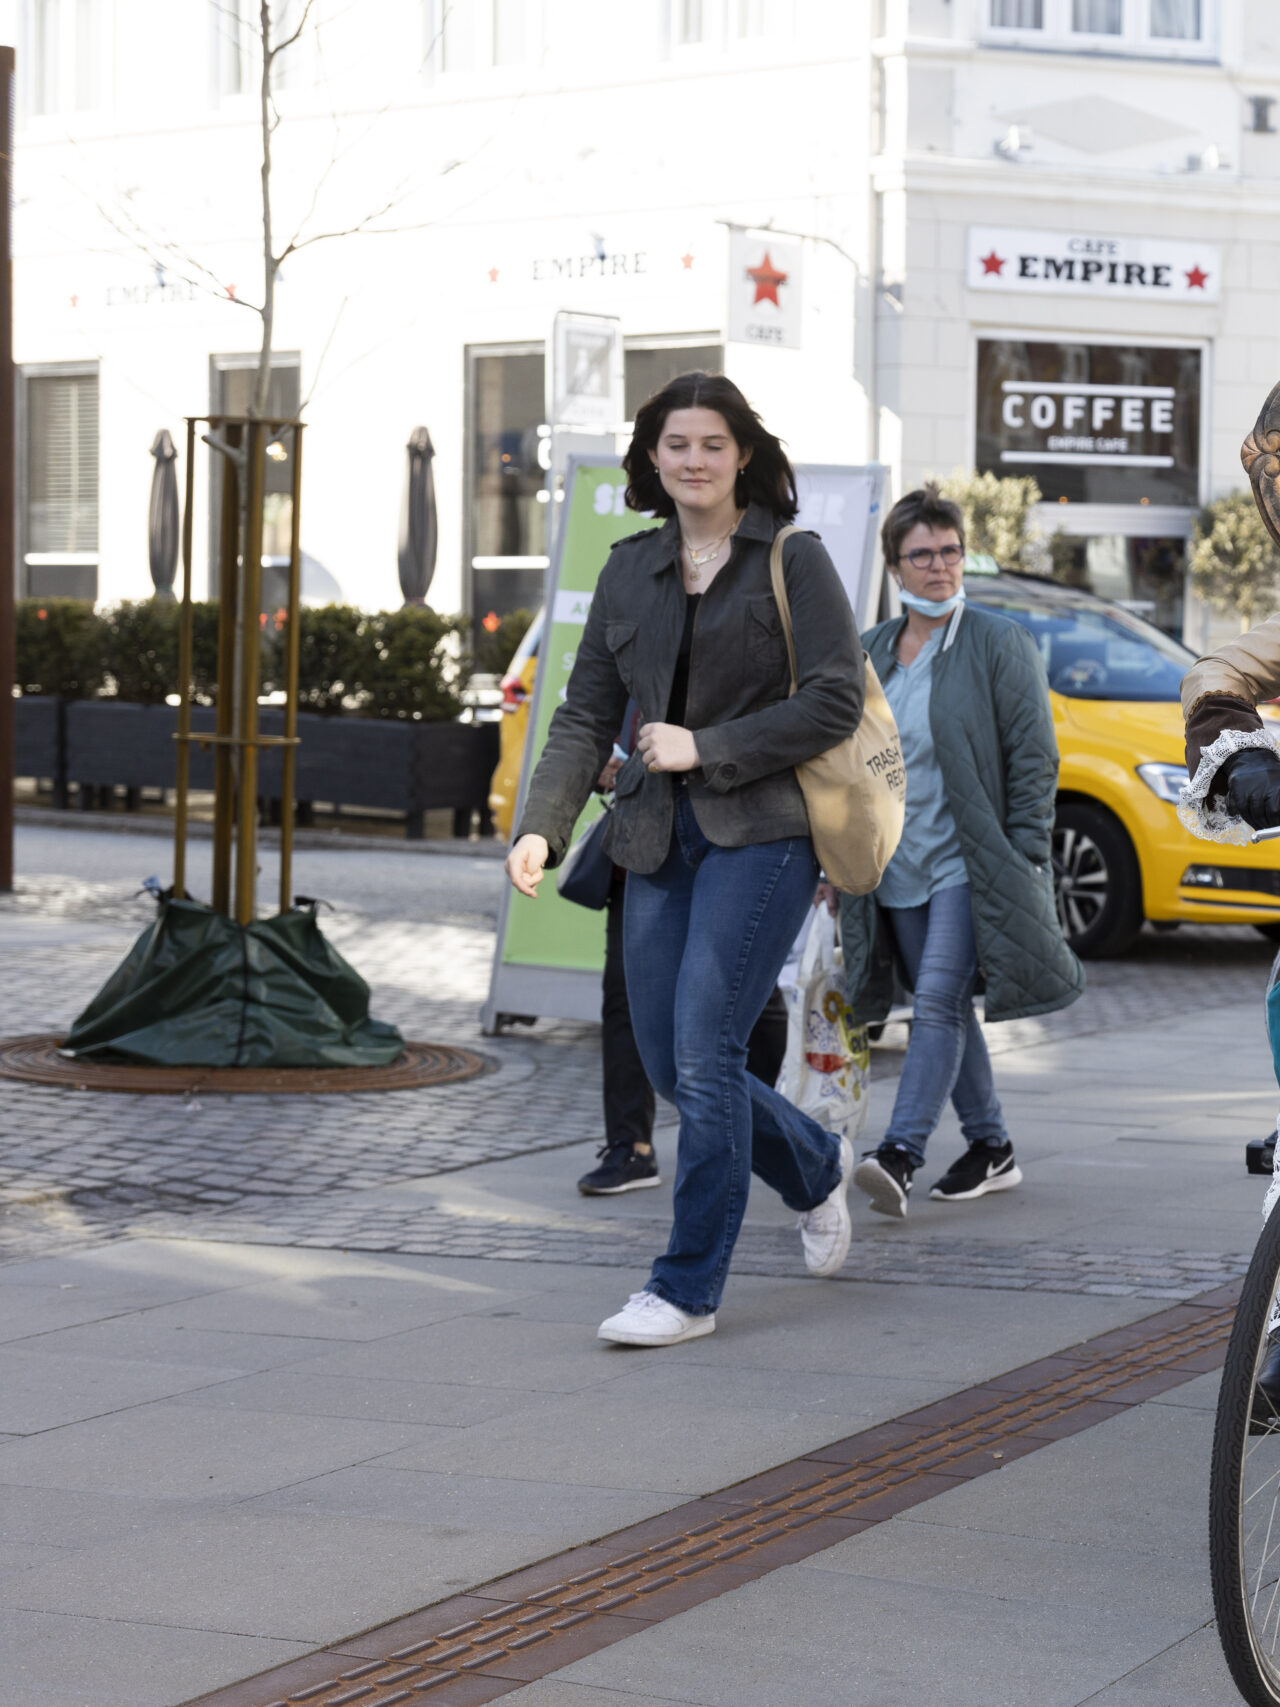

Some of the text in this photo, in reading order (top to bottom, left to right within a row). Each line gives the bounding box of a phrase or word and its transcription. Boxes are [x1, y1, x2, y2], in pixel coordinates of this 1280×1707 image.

[532, 251, 648, 281] EMPIRE
[1017, 255, 1172, 288] EMPIRE
[1002, 393, 1175, 433] COFFEE
[865, 744, 901, 777] TRASH
